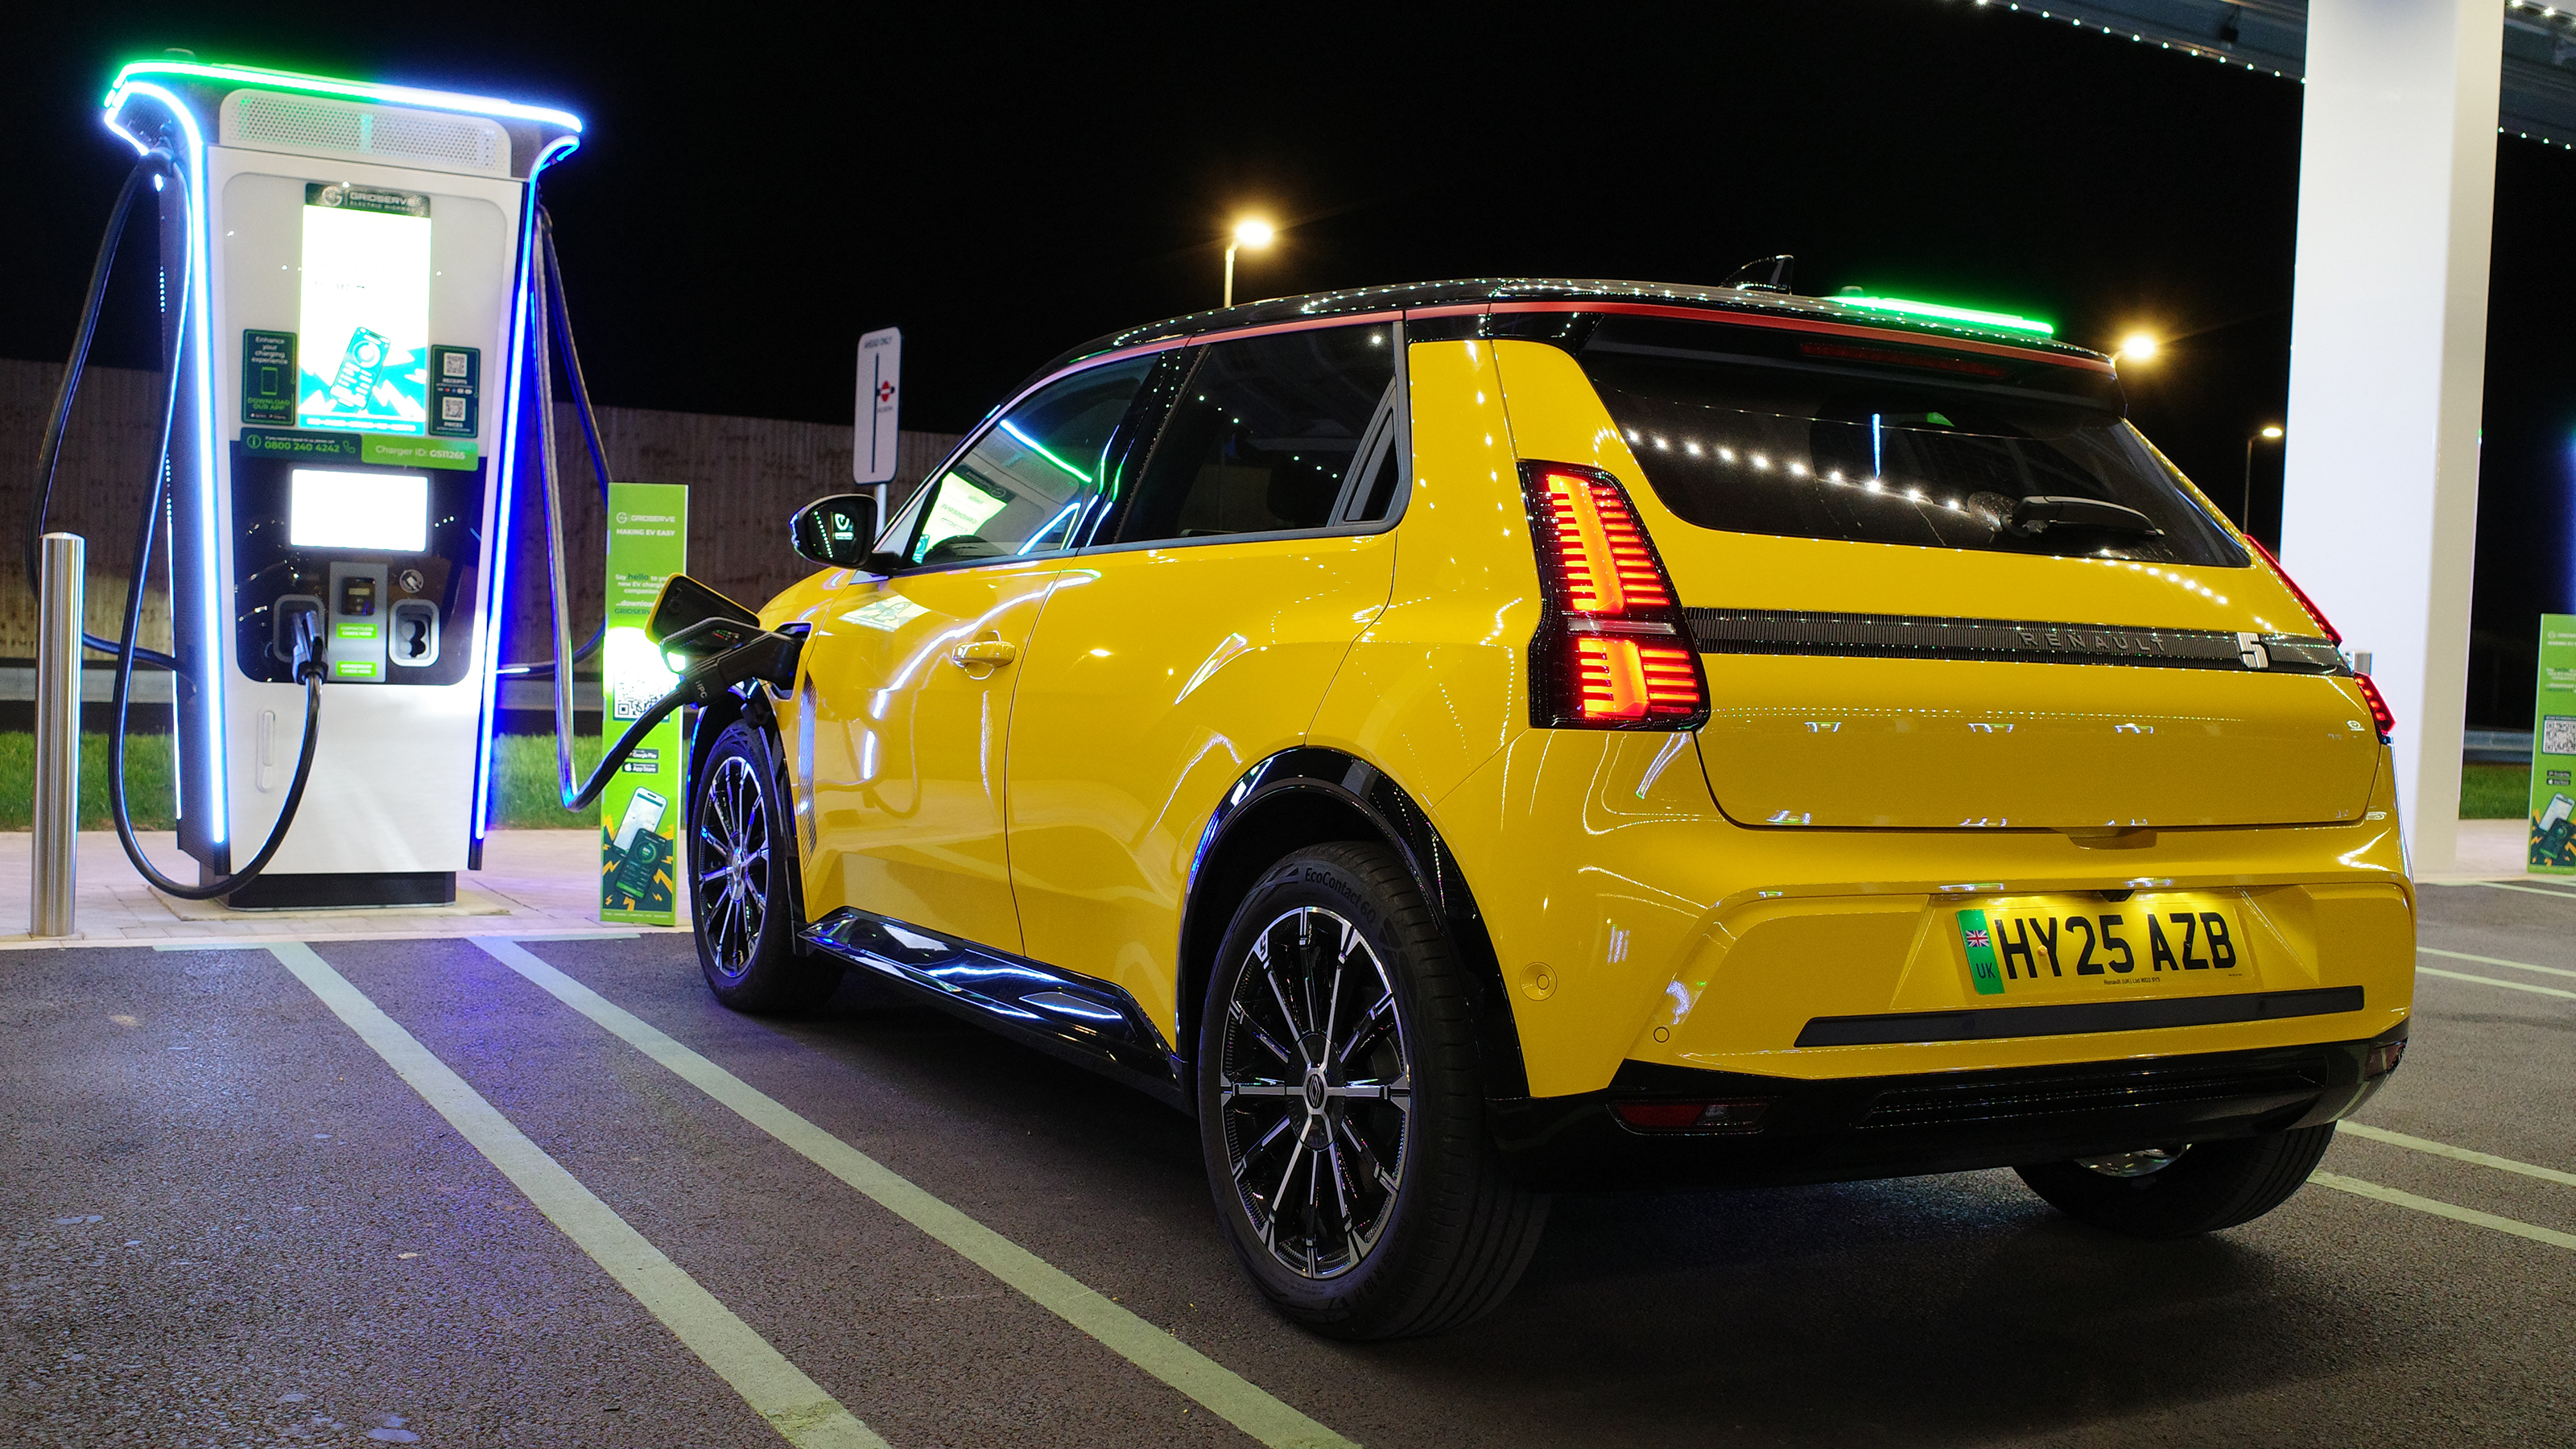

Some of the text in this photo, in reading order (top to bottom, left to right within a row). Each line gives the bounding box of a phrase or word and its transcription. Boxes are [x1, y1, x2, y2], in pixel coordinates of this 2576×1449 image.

[255, 336, 285, 345] Enhance
[265, 440, 341, 453] 0800 240 4242
[375, 445, 413, 456] Charger
[430, 449, 465, 460] GS11265
[631, 515, 676, 523] GRIDSERVE
[657, 530, 676, 538] EASY
[2020, 631, 2268, 669] RENAULT 5
[1305, 868, 1361, 908] EcoContact
[1994, 911, 2236, 980] HY25 AZB
[1975, 963, 1996, 980] UK
